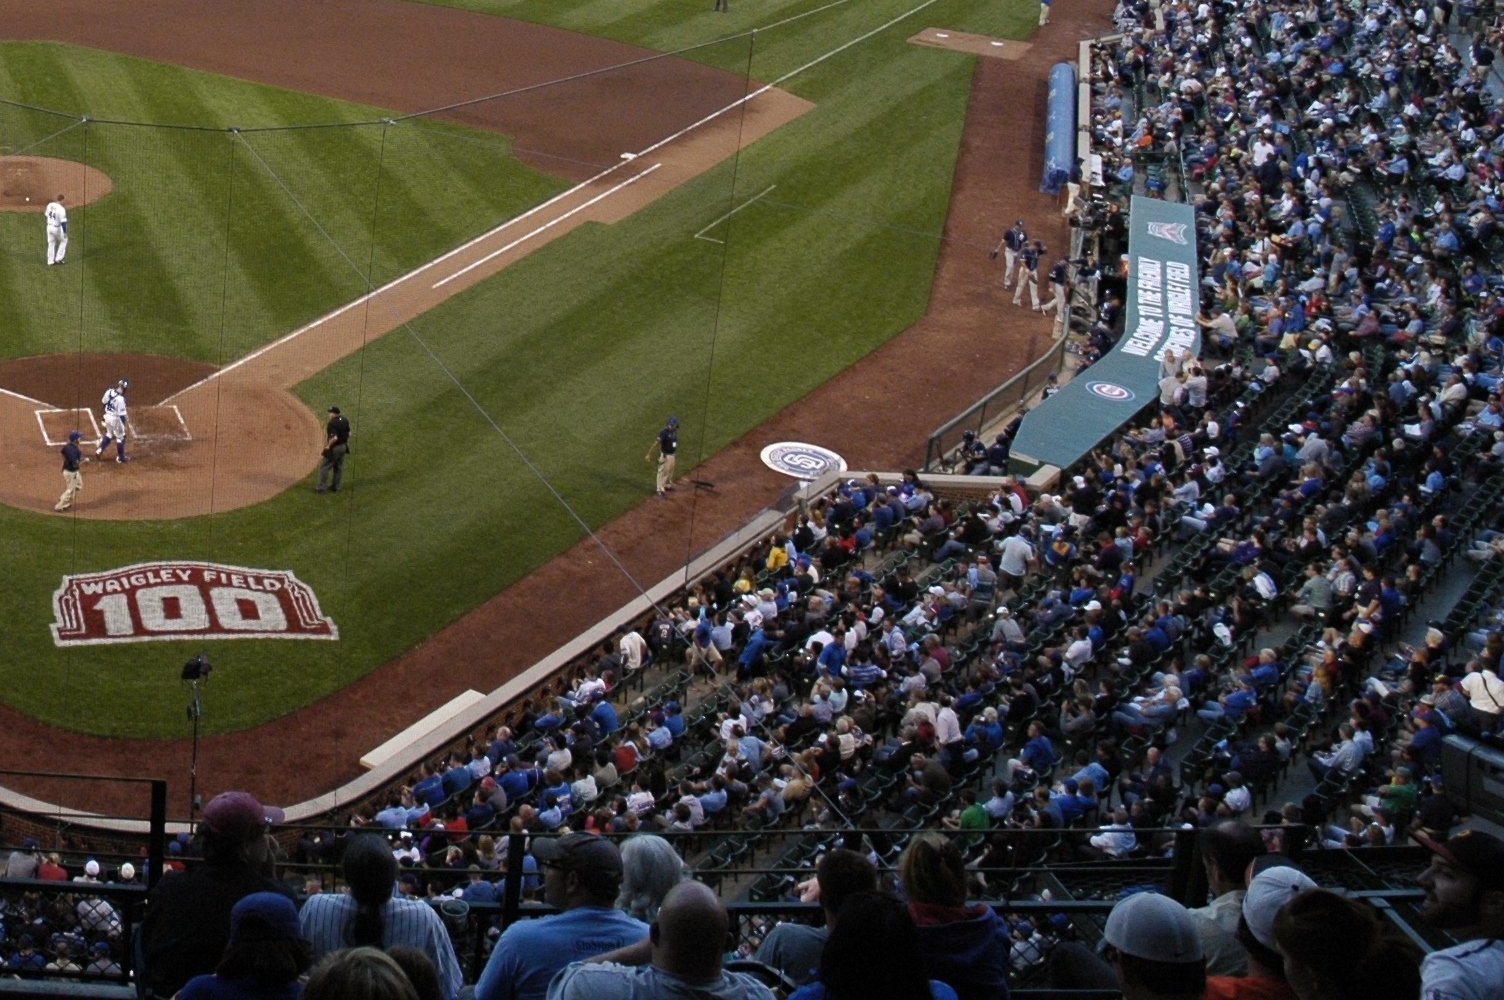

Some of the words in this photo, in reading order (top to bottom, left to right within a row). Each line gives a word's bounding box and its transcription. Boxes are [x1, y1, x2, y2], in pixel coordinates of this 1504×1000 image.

[1137, 255, 1162, 292] FRIENDLY
[1165, 261, 1190, 283] FIELD
[1137, 289, 1163, 306] THE
[1167, 281, 1193, 316] WRIGLEY
[1137, 305, 1164, 318] TO
[1168, 313, 1195, 328] OF
[1119, 317, 1165, 357] WELCOME
[81, 569, 192, 595] WRIGLEY
[202, 569, 283, 591] FIELD
[93, 584, 288, 636] 100
